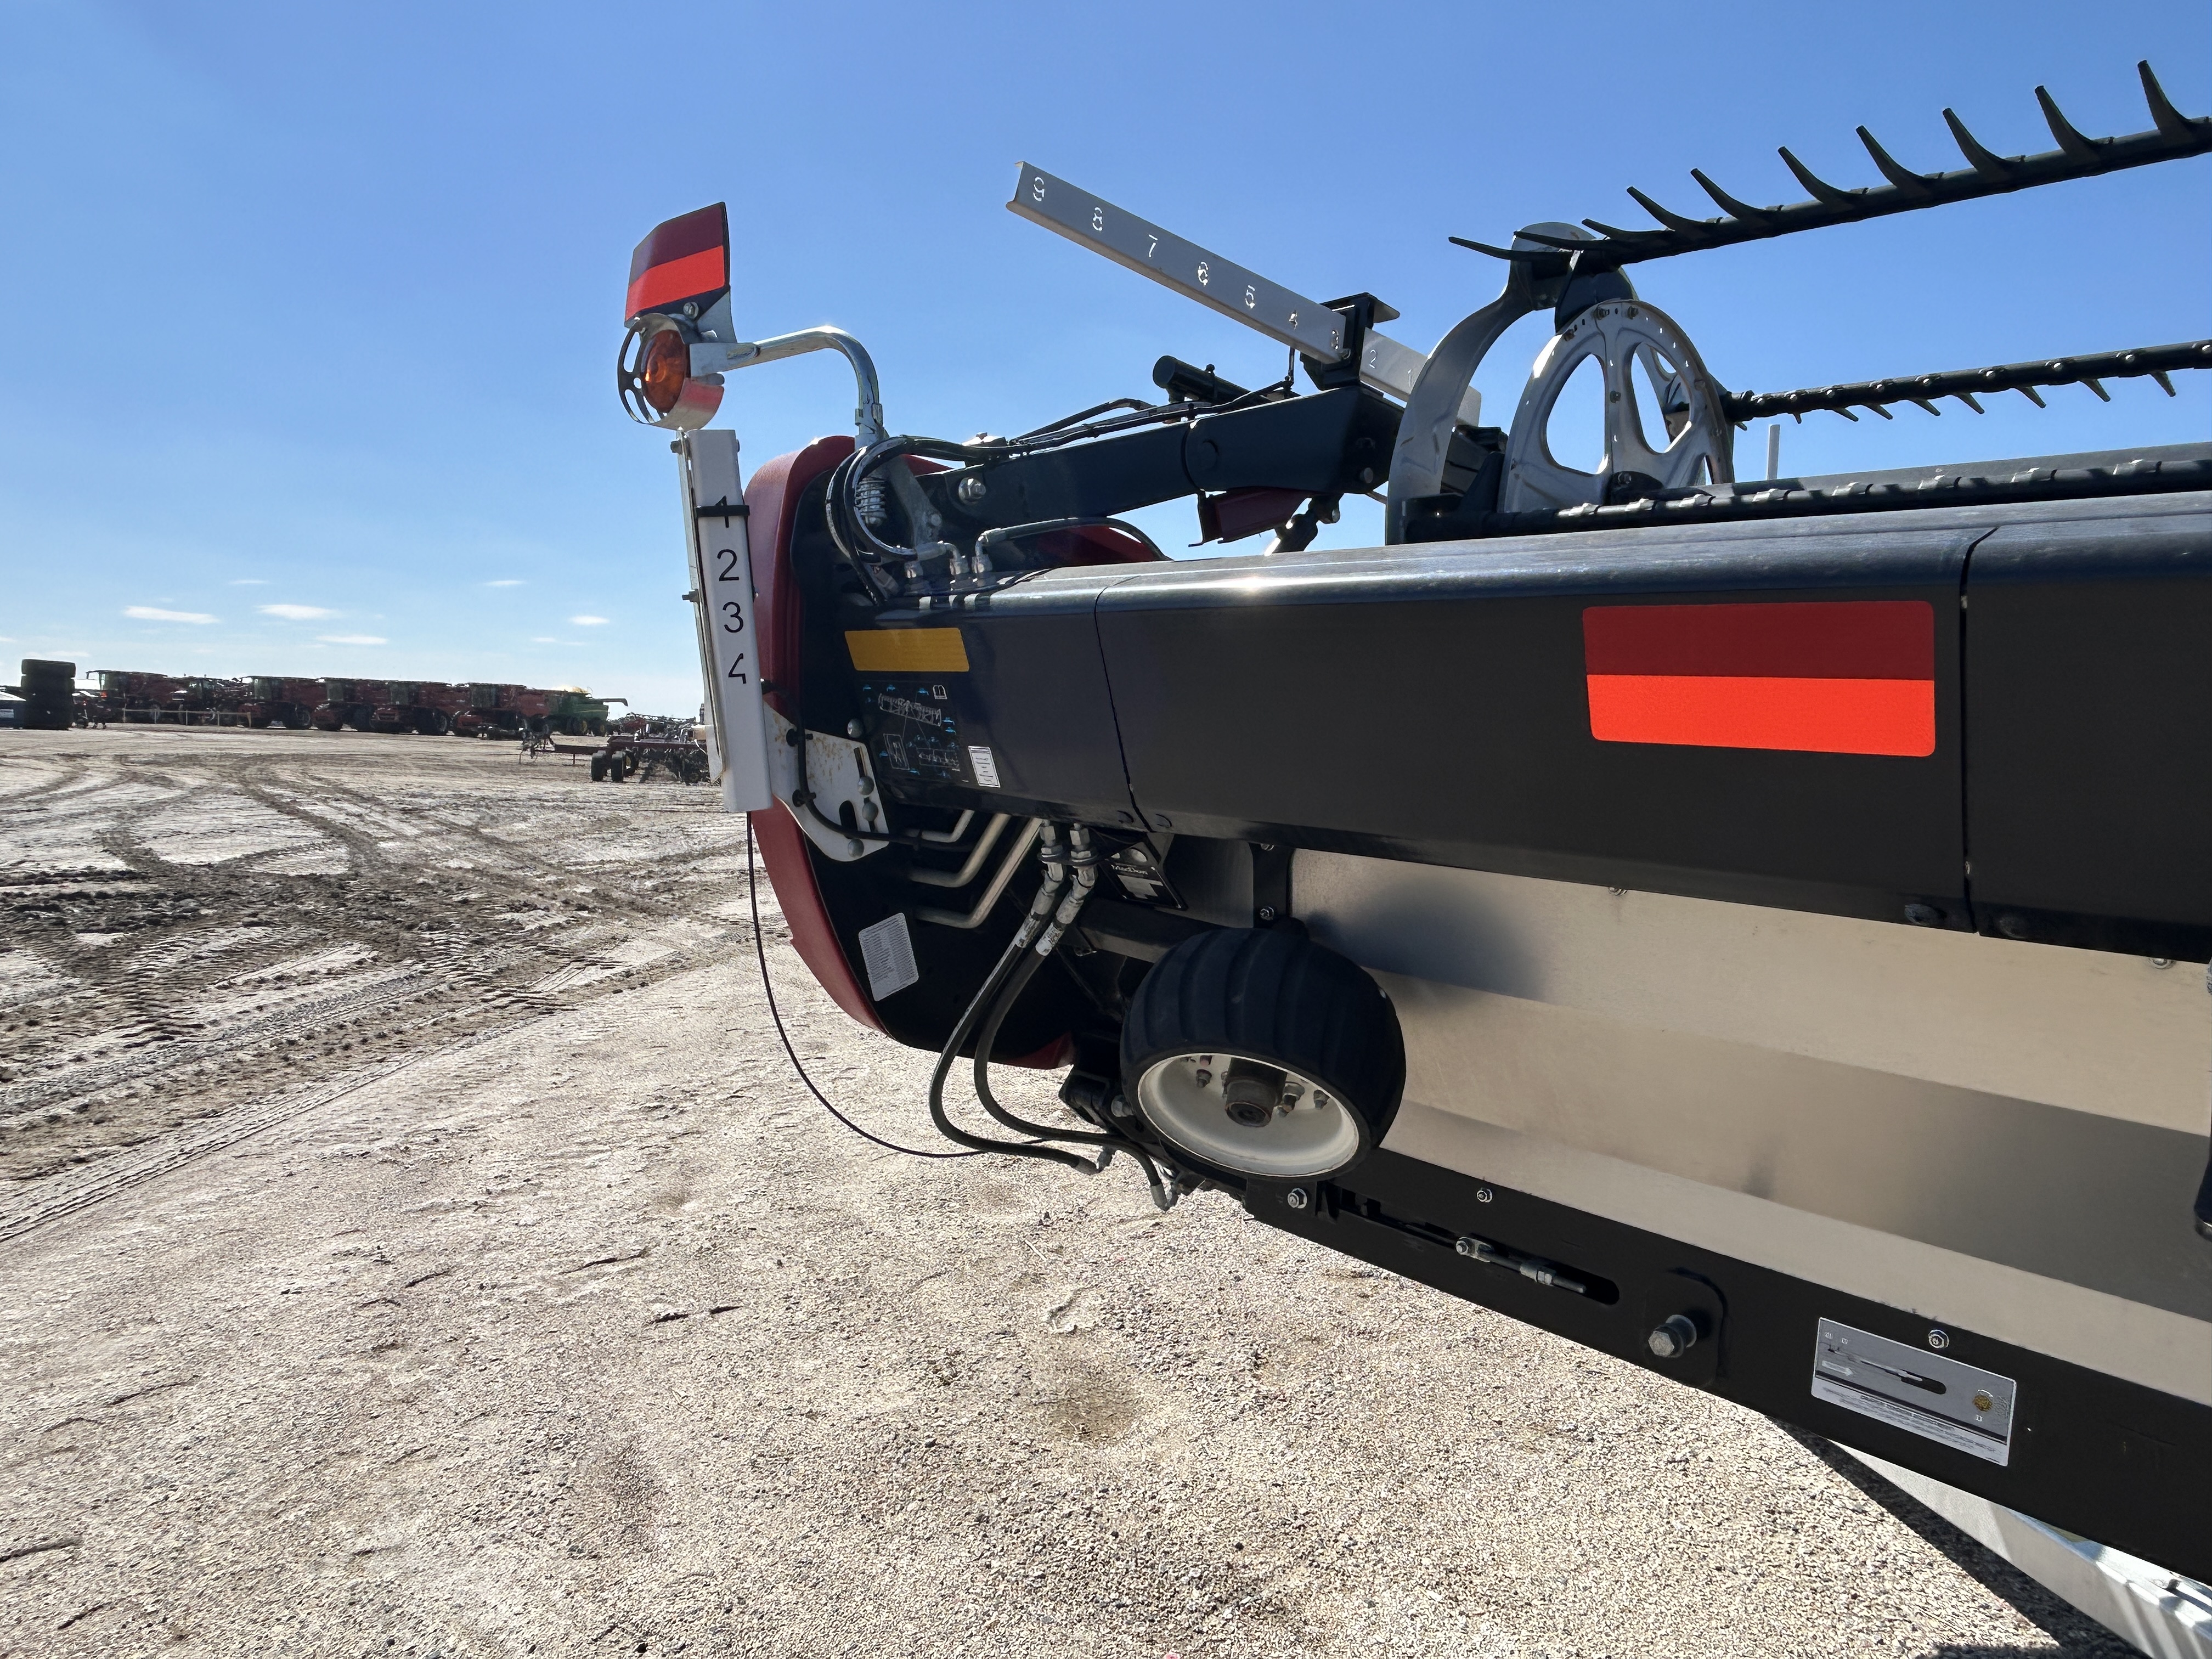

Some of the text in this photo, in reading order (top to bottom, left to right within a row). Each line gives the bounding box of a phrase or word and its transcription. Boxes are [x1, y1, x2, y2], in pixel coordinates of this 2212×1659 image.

[1033, 177, 1045, 201] 9
[1092, 207, 1103, 232] 8
[1148, 234, 1158, 258] 7
[1198, 261, 1208, 286] 6
[1245, 285, 1256, 309] 5
[1289, 310, 1297, 330] 4
[1369, 349, 1378, 369] 2
[717, 549, 740, 582] 2
[722, 601, 744, 633] 3
[728, 653, 747, 685] 4
